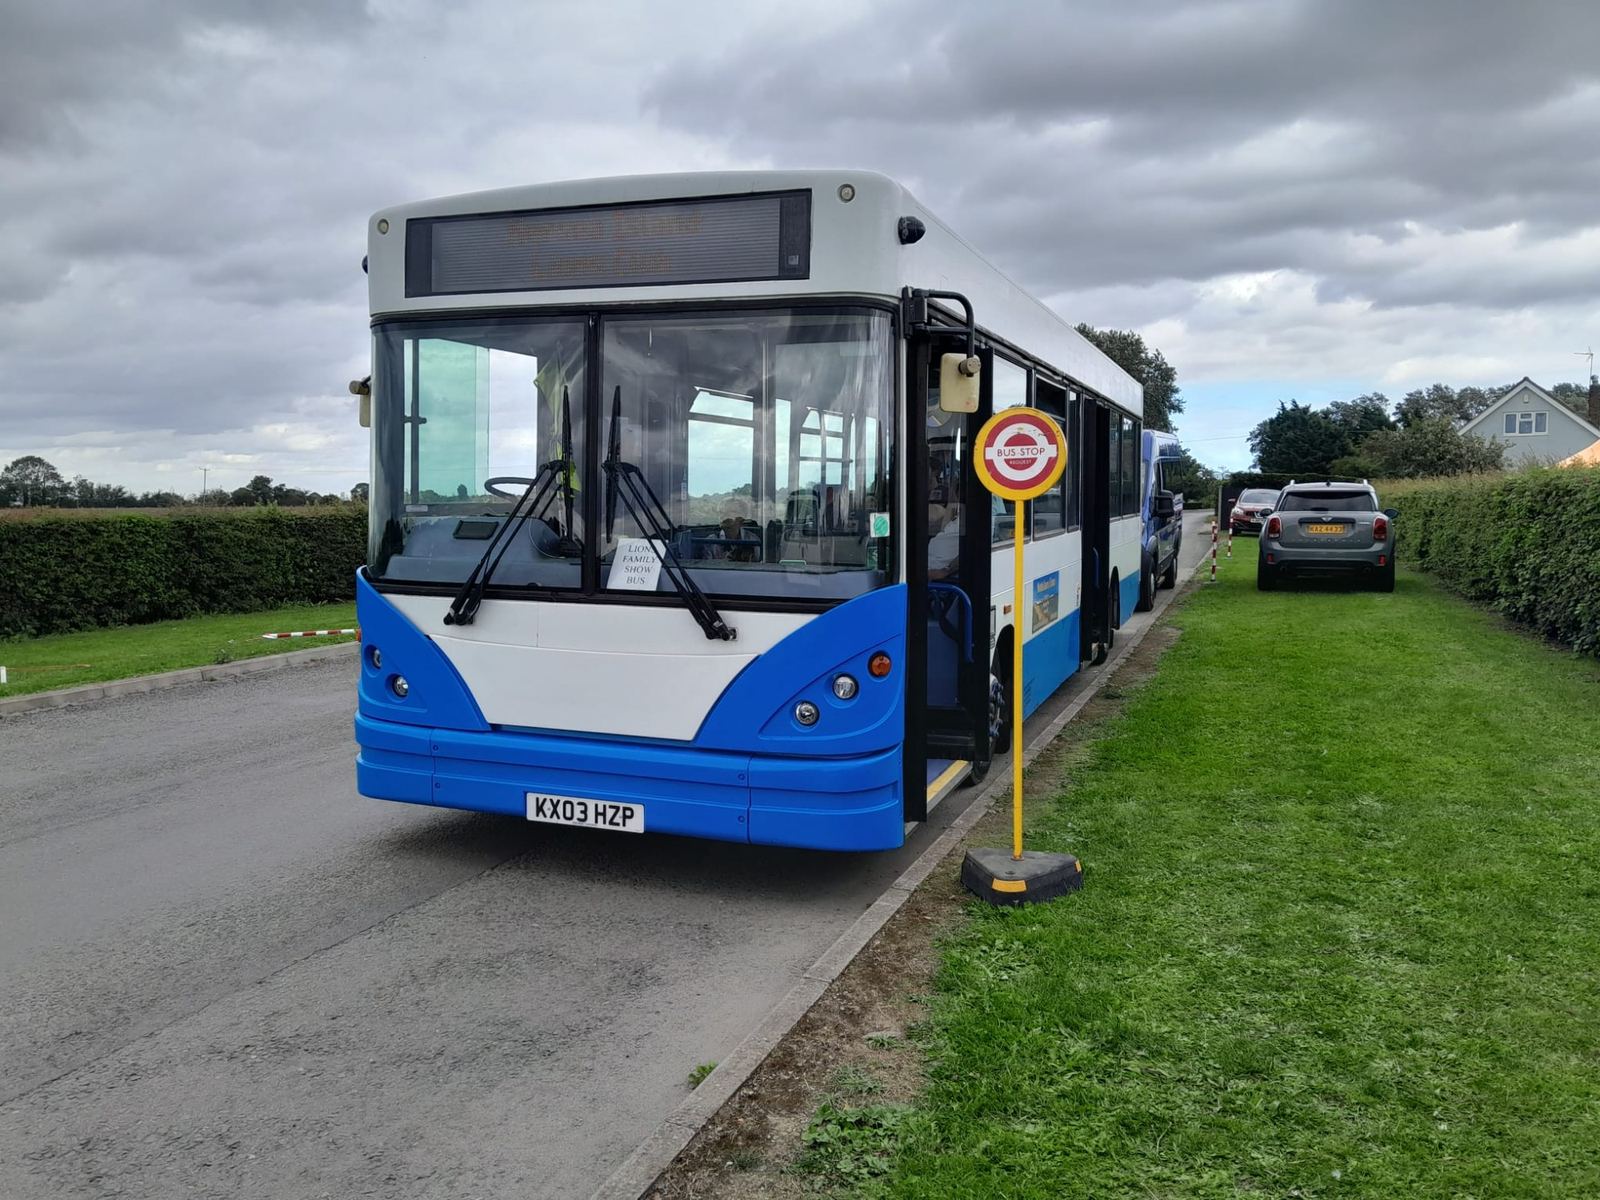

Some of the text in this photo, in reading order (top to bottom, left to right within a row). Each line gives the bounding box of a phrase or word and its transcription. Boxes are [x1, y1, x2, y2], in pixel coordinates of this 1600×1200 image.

[997, 447, 1046, 457] BUS STOP
[622, 555, 657, 564] FAMILY
[624, 565, 654, 574] SHOW
[626, 576, 646, 585] BUS
[535, 796, 634, 827] KX03 HZP
